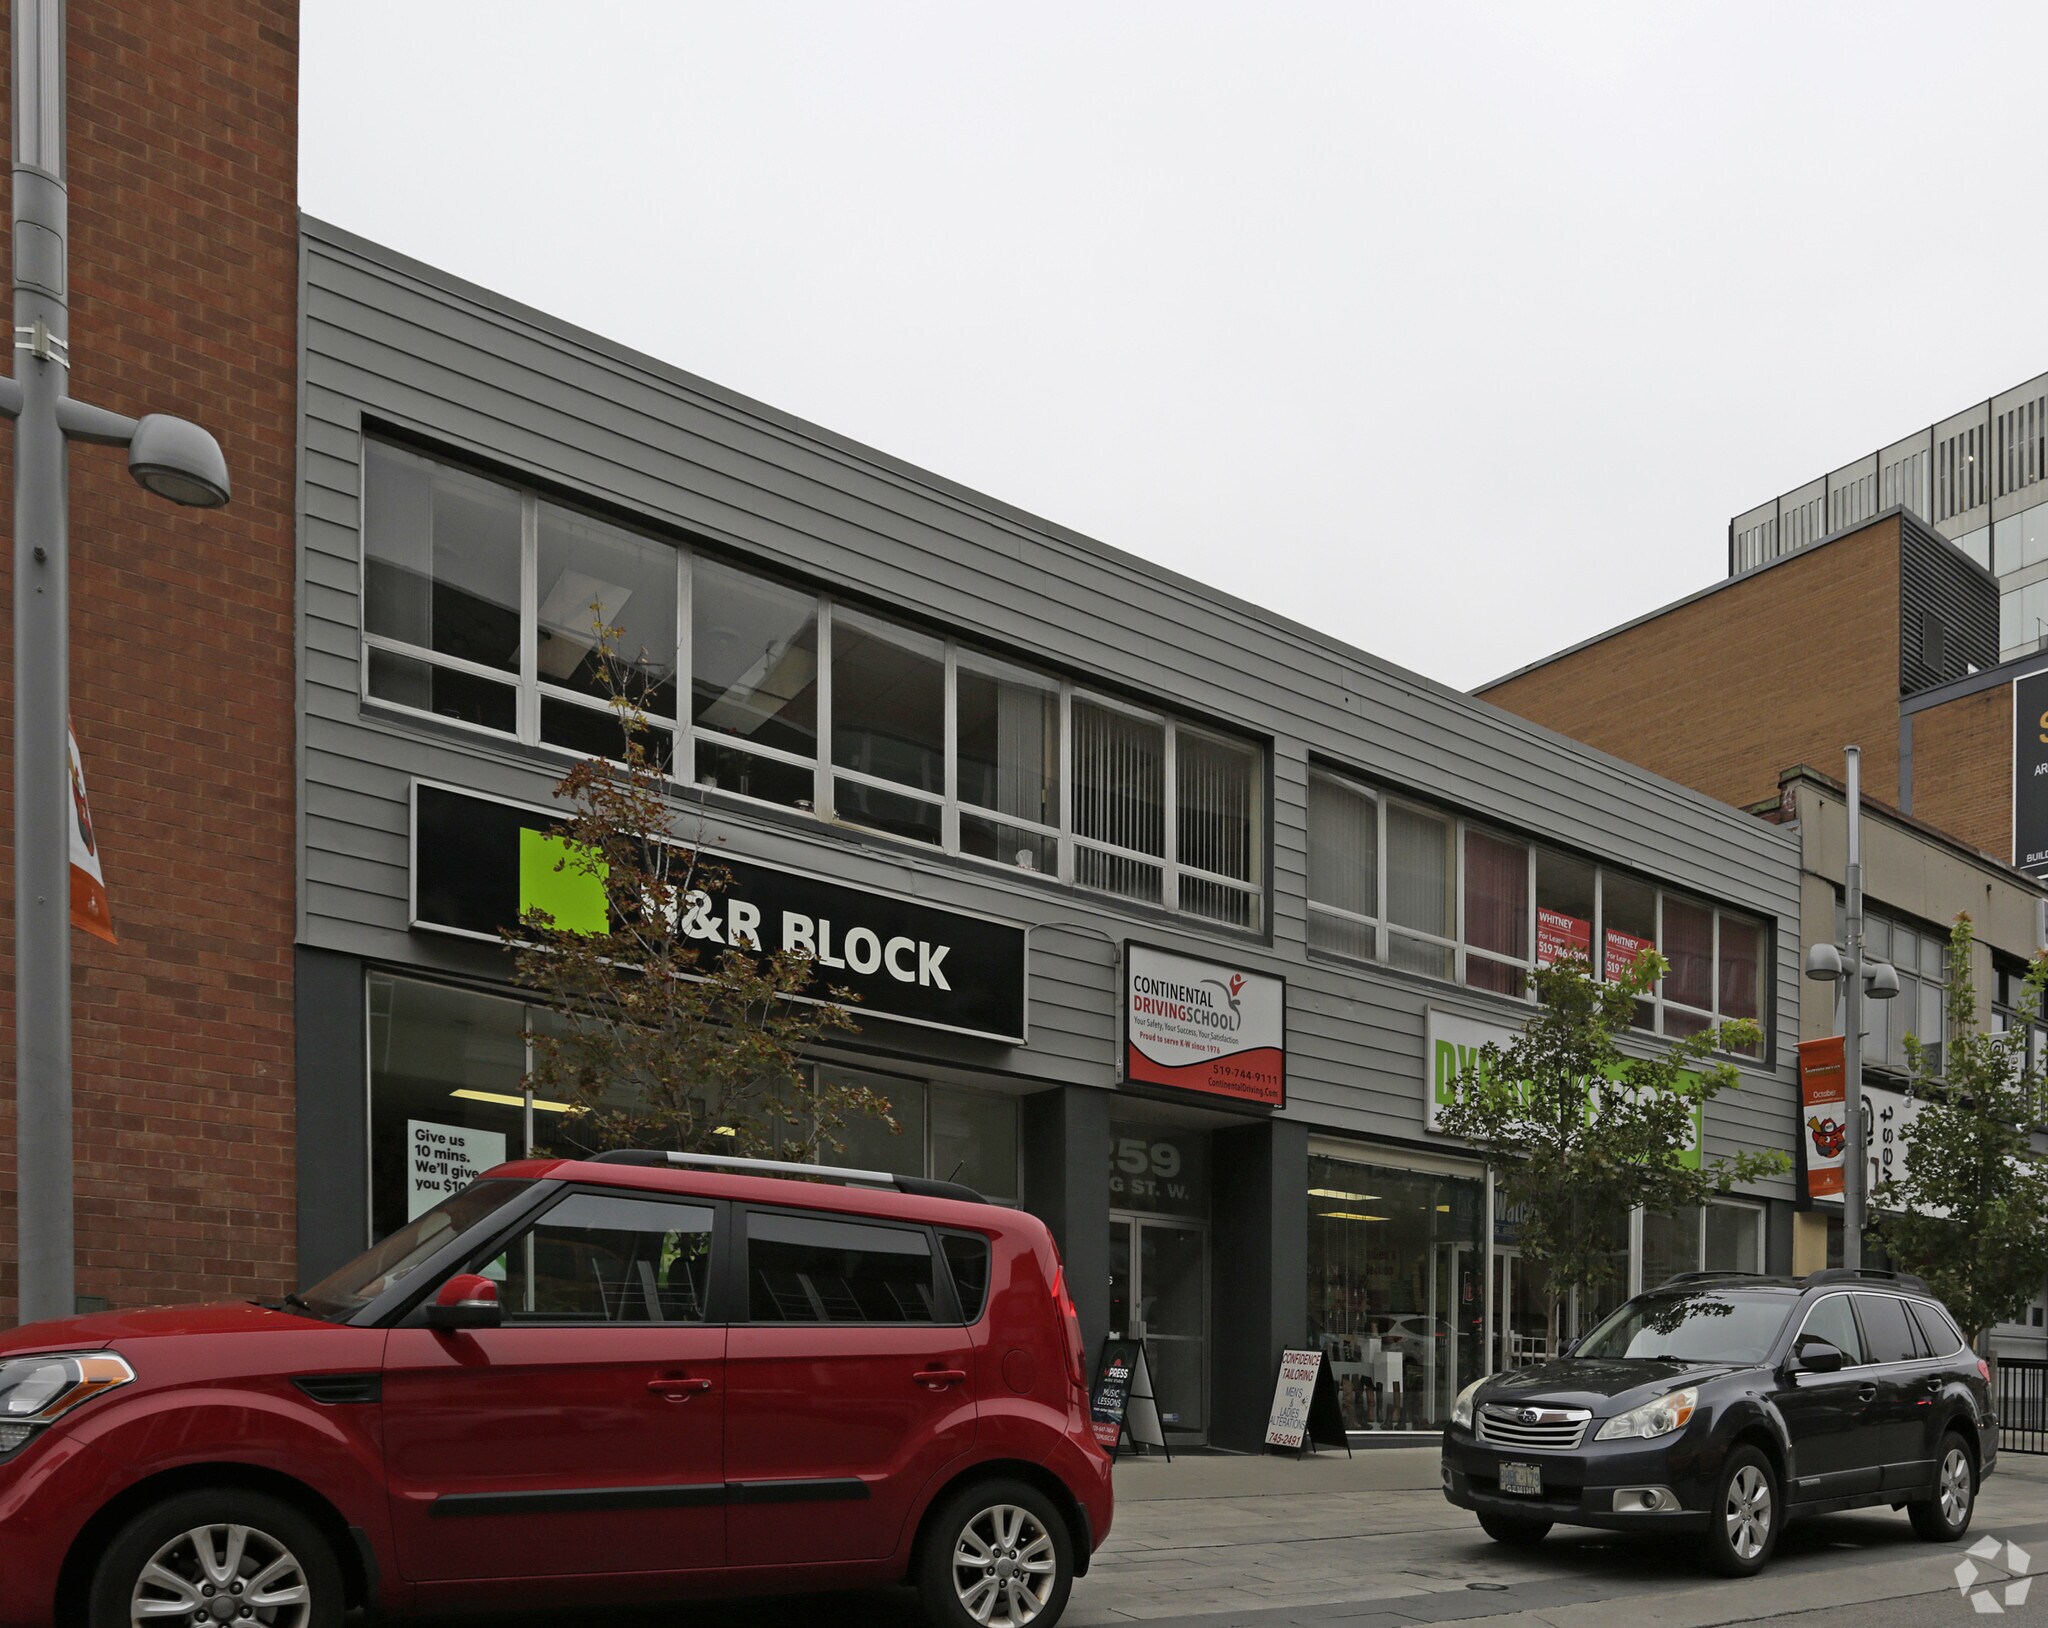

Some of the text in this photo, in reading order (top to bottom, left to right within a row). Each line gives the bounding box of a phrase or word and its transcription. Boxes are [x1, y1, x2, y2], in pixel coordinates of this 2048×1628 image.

[1539, 911, 1573, 930] WHITNEY
[1538, 931, 1548, 940] For
[1607, 932, 1639, 950] WHITNEY
[782, 910, 952, 991] BLOCK
[1538, 941, 1553, 955] 519
[1606, 951, 1616, 960] For
[1606, 961, 1620, 974] 519
[1134, 975, 1213, 1008] CONTINENTAL
[1133, 1015, 1239, 1045] Your Safety, Your Success, Your Satisfaction
[1139, 1031, 1221, 1055] Proud to serve K-W since 1976
[1213, 1065, 1278, 1085] 519-744-9111
[1208, 1077, 1278, 1098] ContinentalDriving.Com
[1813, 1089, 1836, 1099] October
[415, 1129, 465, 1147] Give us
[415, 1144, 470, 1163] 10 mins.
[415, 1159, 479, 1180] We'll give
[415, 1178, 440, 1191] you
[1131, 1179, 1160, 1197] ST.
[1167, 1183, 1190, 1200] W.
[1282, 1352, 1321, 1366] CONFIDENCE
[1282, 1368, 1314, 1382] TAILORING
[1102, 1387, 1120, 1398] MUSIC
[1097, 1396, 1122, 1408] LESSONS
[1279, 1406, 1300, 1419] LADIES
[1269, 1415, 1306, 1430] ALTERATIONS
[1269, 1432, 1301, 1446] 745-2491
